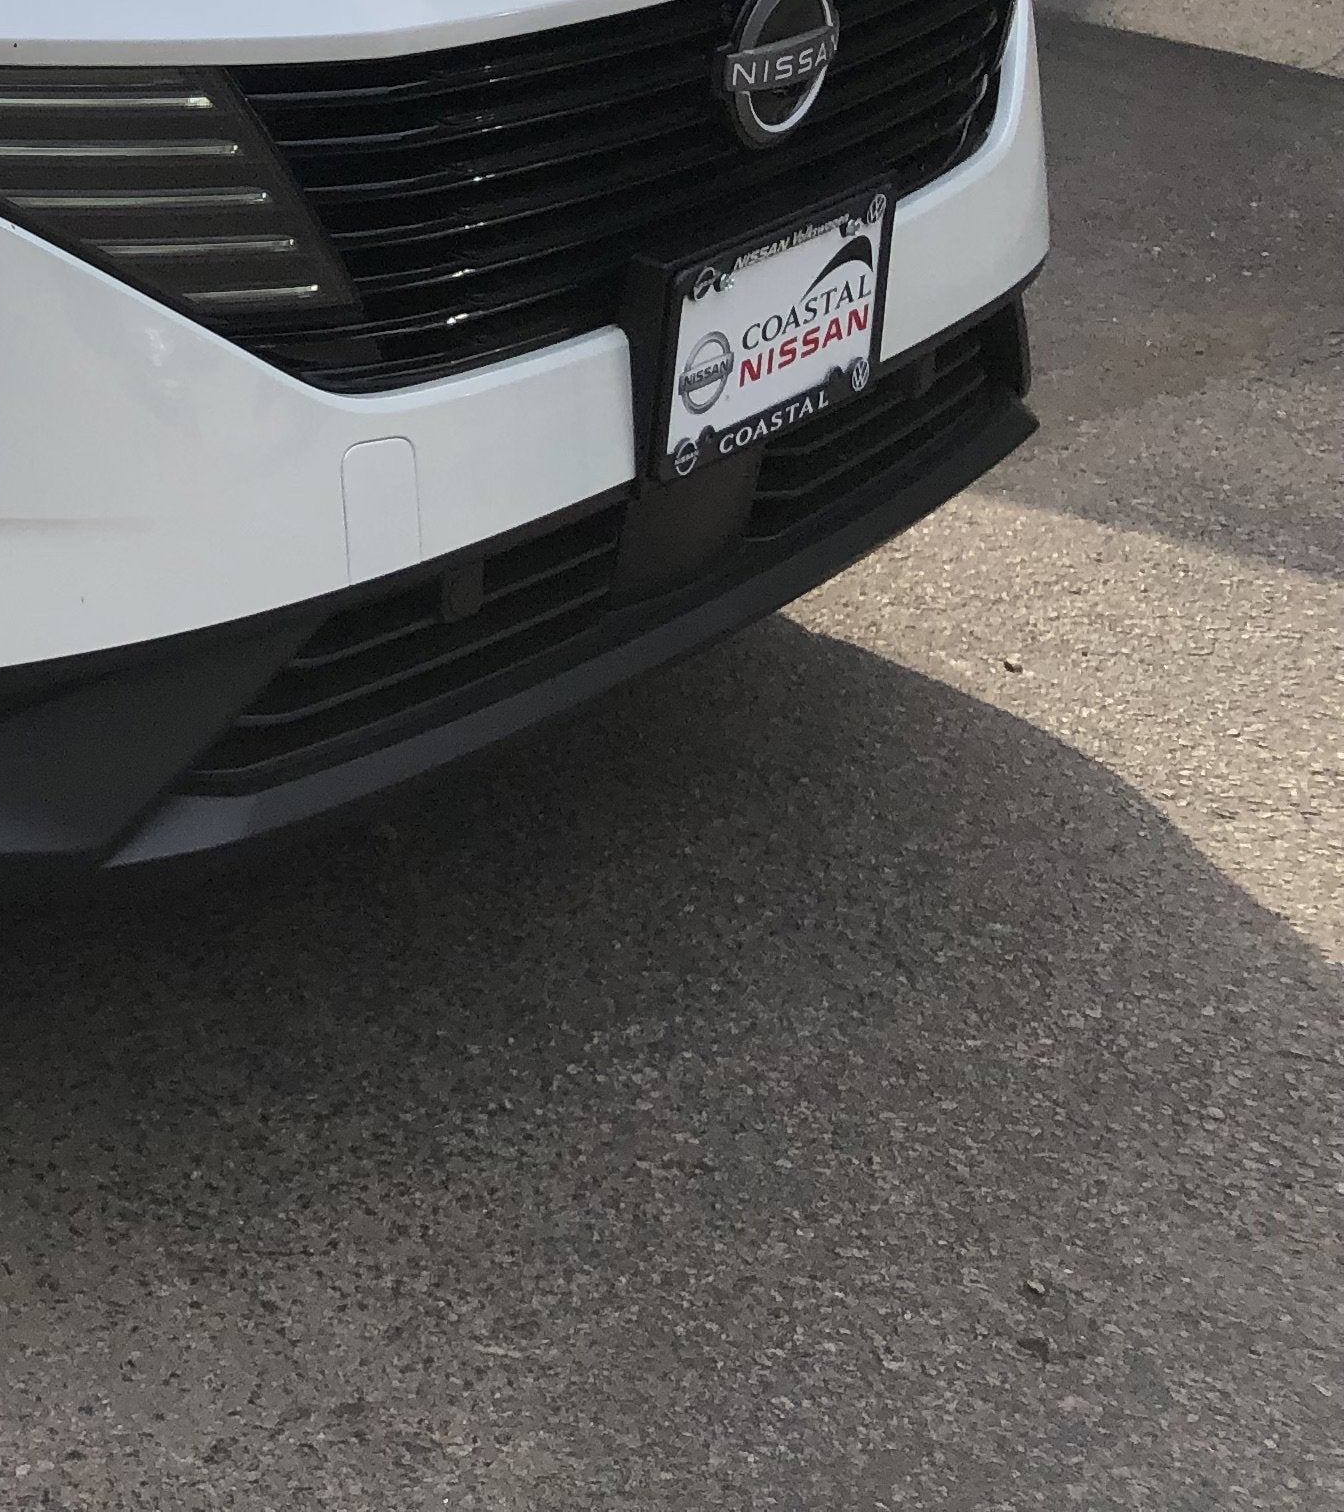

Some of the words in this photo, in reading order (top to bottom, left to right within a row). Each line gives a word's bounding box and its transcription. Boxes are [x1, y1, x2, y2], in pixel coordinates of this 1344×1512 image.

[733, 236, 791, 271] NISSAN
[742, 274, 872, 351] COASTAL
[684, 358, 729, 386] NISSAN
[739, 303, 869, 388] NISSAN
[719, 390, 829, 454] COASTAL
